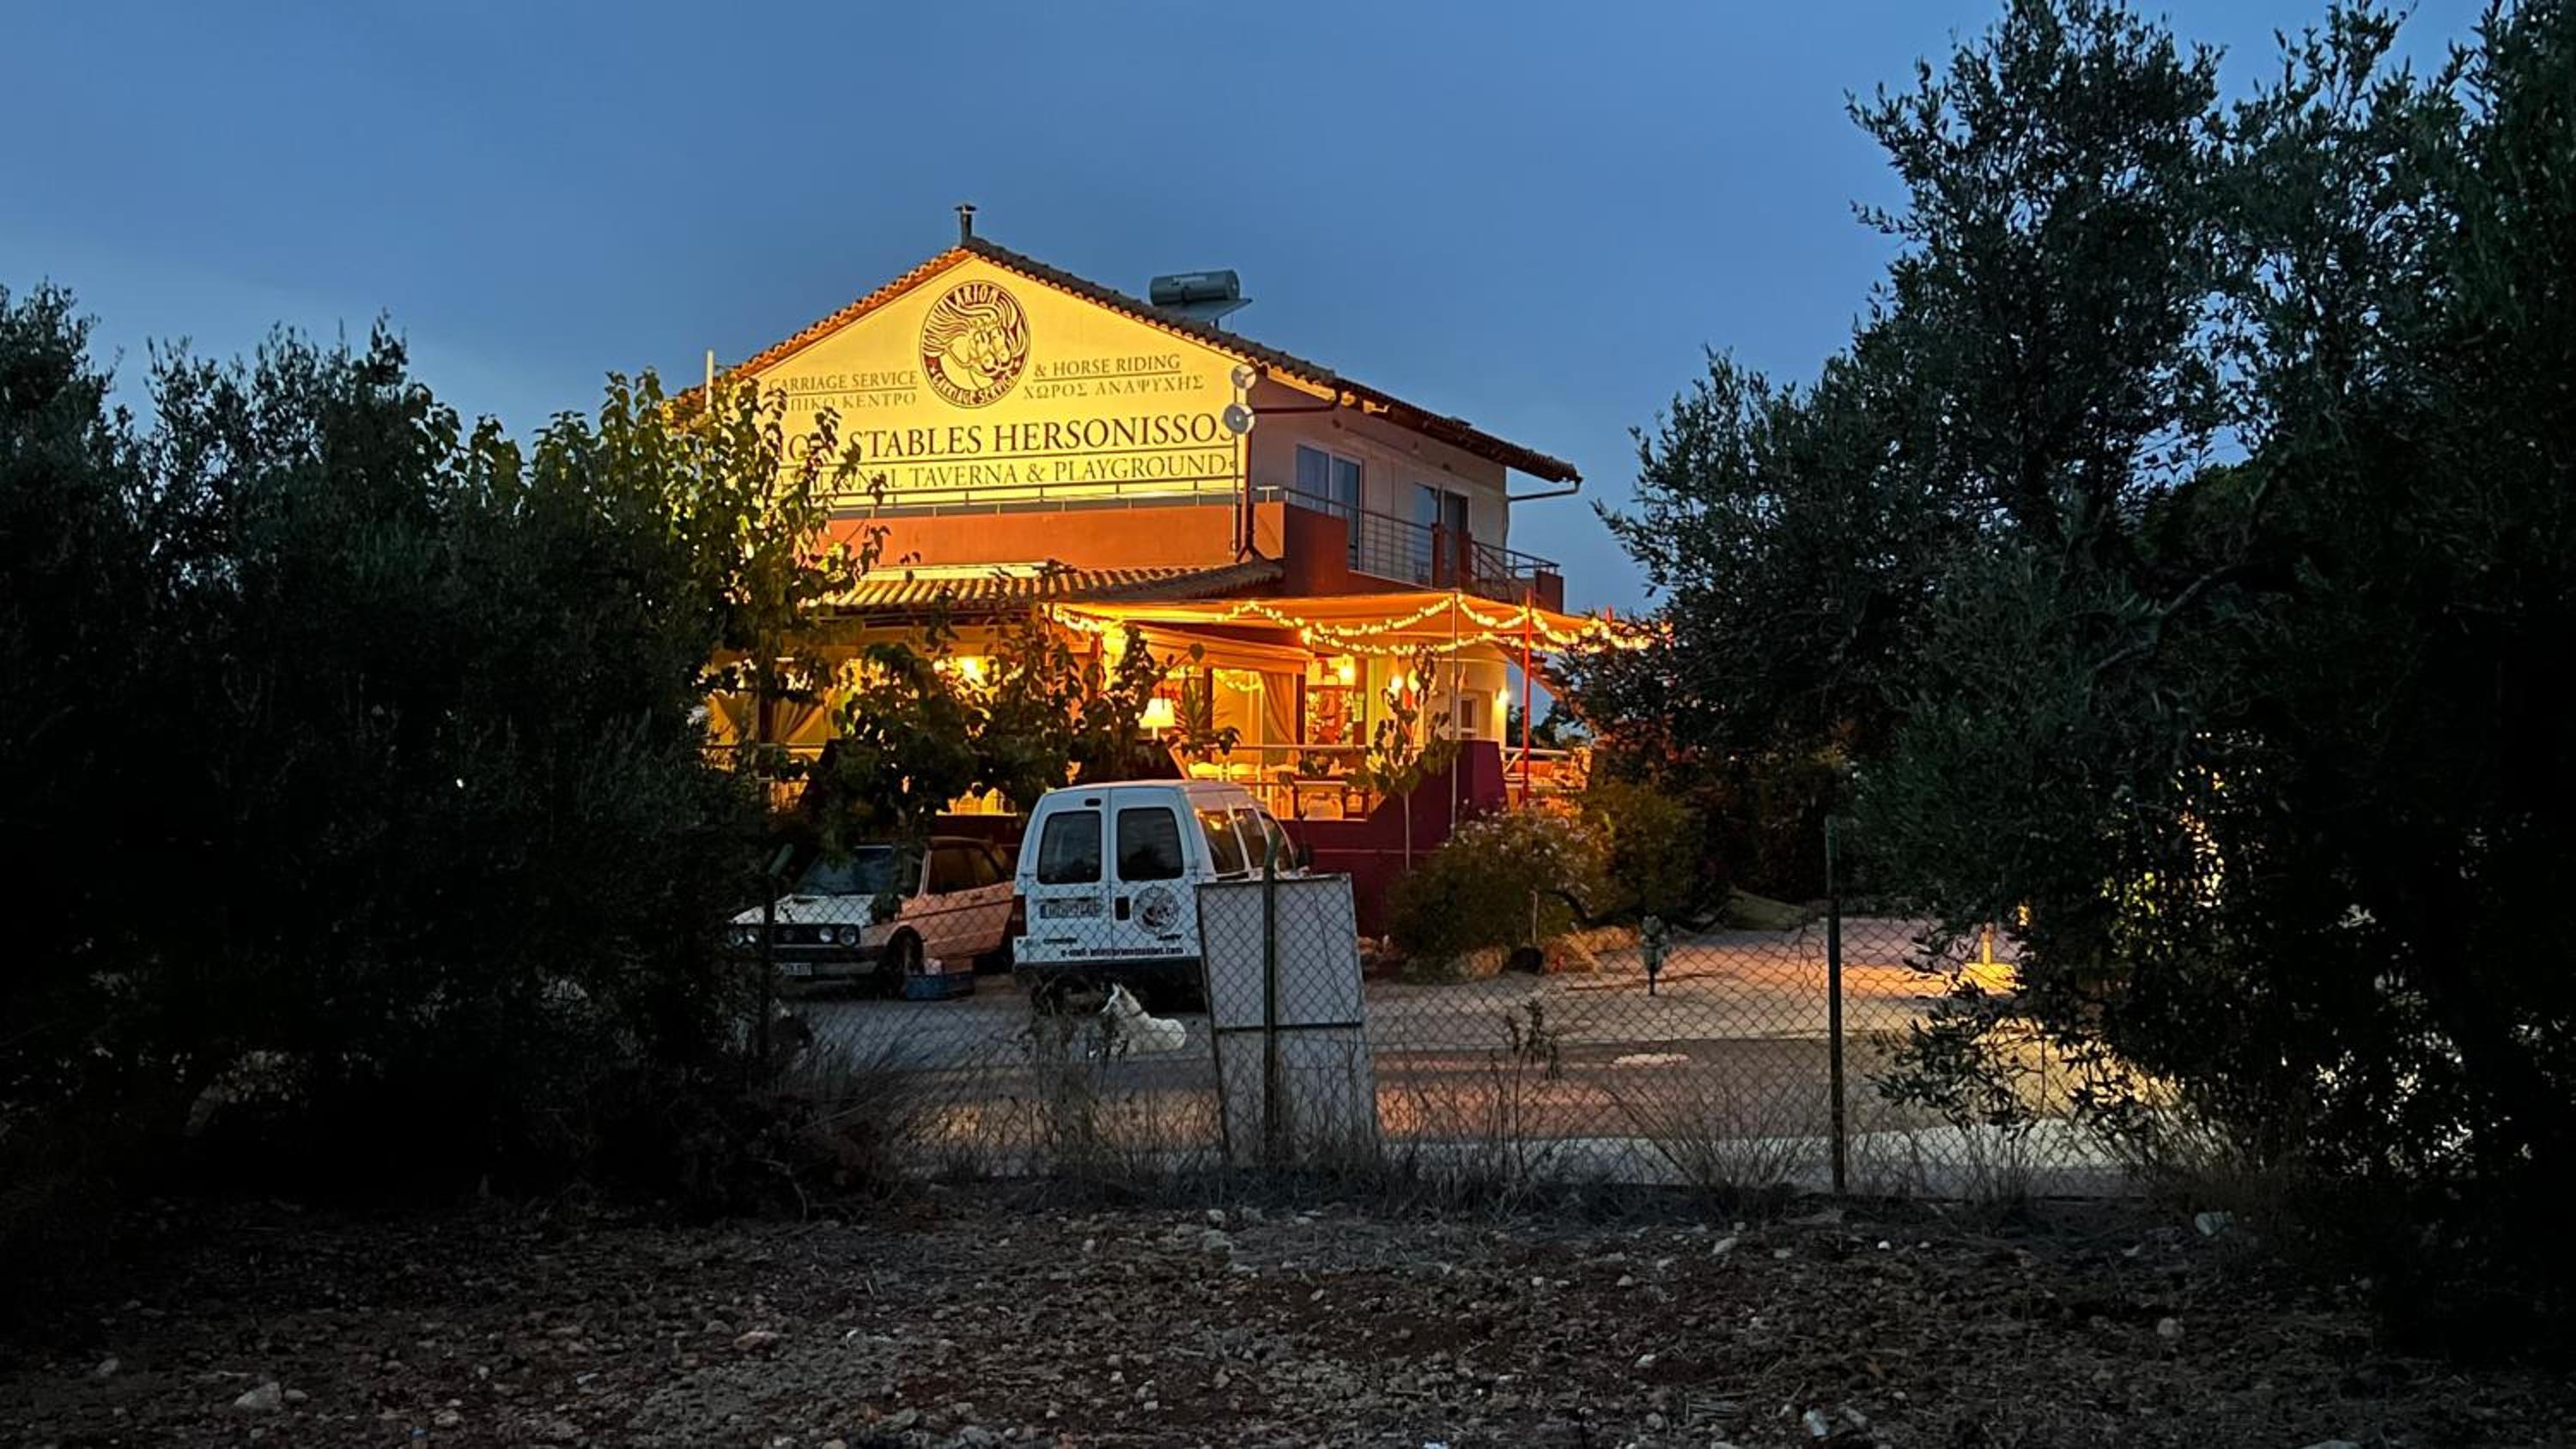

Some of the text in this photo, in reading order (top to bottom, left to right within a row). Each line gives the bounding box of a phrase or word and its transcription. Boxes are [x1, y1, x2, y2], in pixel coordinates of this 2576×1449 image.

[1034, 354, 1181, 378] & HORSE RIDING
[769, 370, 918, 391] CARRIAGE SERVICE
[790, 396, 836, 411] ΠΙΚΟ
[908, 461, 1018, 488] TAVERNA
[1026, 464, 1046, 482] &
[1054, 453, 1227, 482] PLAYGROUND
